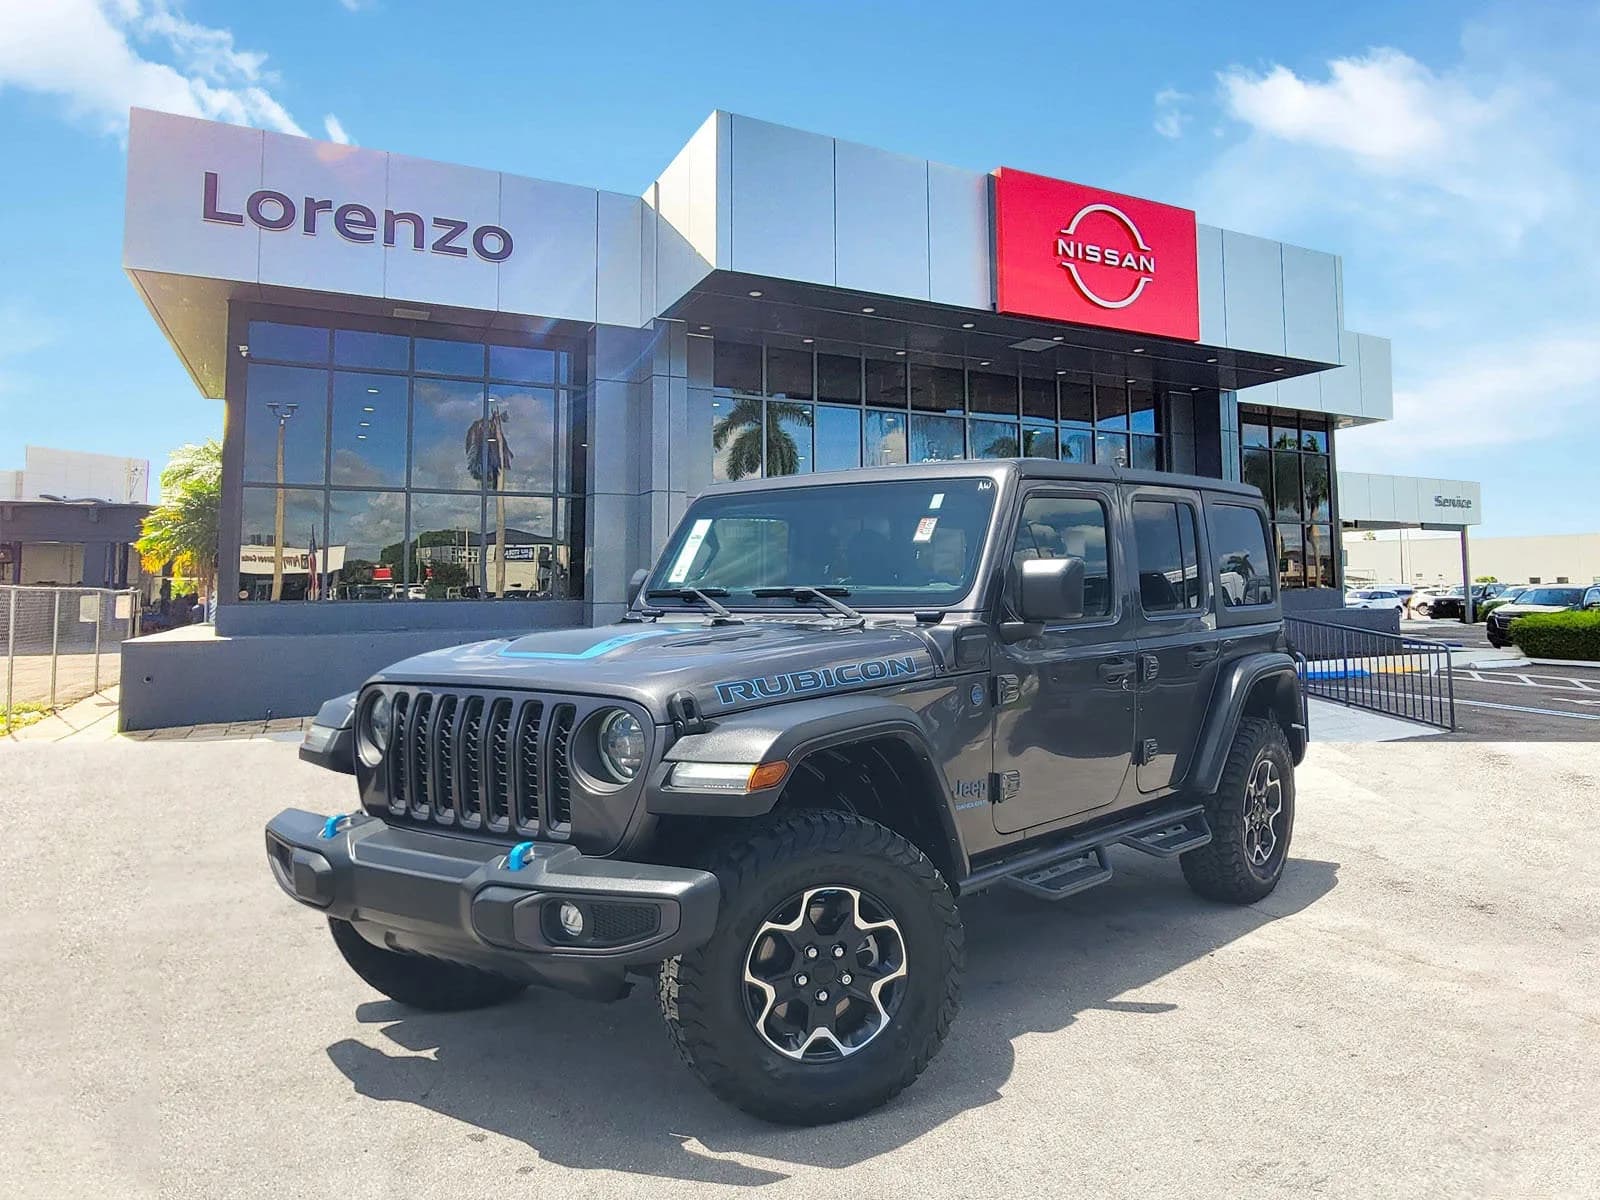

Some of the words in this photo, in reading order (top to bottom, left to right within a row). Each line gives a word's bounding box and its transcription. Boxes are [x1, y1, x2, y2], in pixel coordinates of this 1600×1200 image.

[202, 170, 514, 263] Lorenzo
[1057, 238, 1155, 273] NISSAN
[1433, 495, 1472, 509] Service
[715, 656, 917, 705] RUBICON
[951, 780, 986, 799] Jeep
